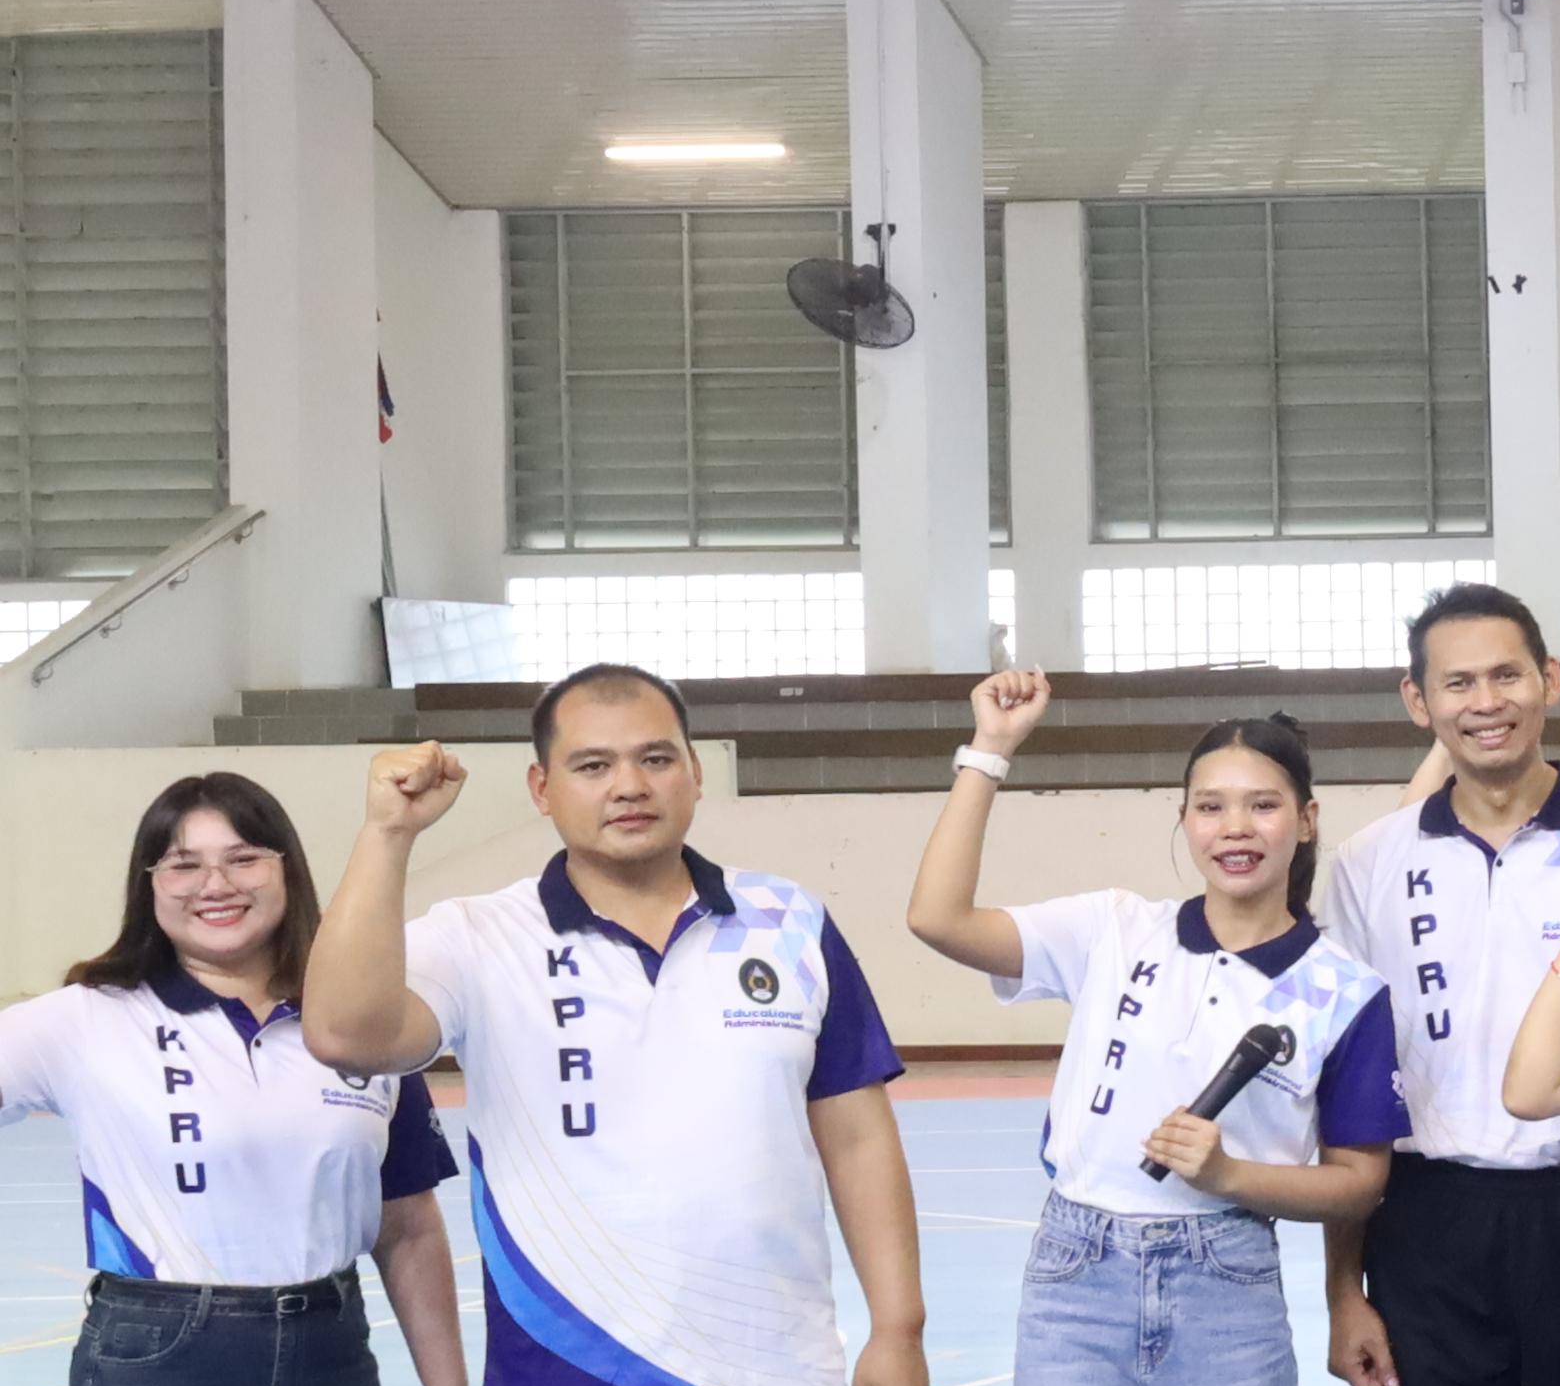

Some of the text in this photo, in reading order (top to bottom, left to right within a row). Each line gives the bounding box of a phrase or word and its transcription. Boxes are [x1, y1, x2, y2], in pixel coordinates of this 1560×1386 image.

[1090, 960, 1160, 1115] KPRU
[1405, 867, 1451, 1042] KPRU
[156, 1025, 207, 1194] KPRU
[546, 945, 597, 1138] KPRU
